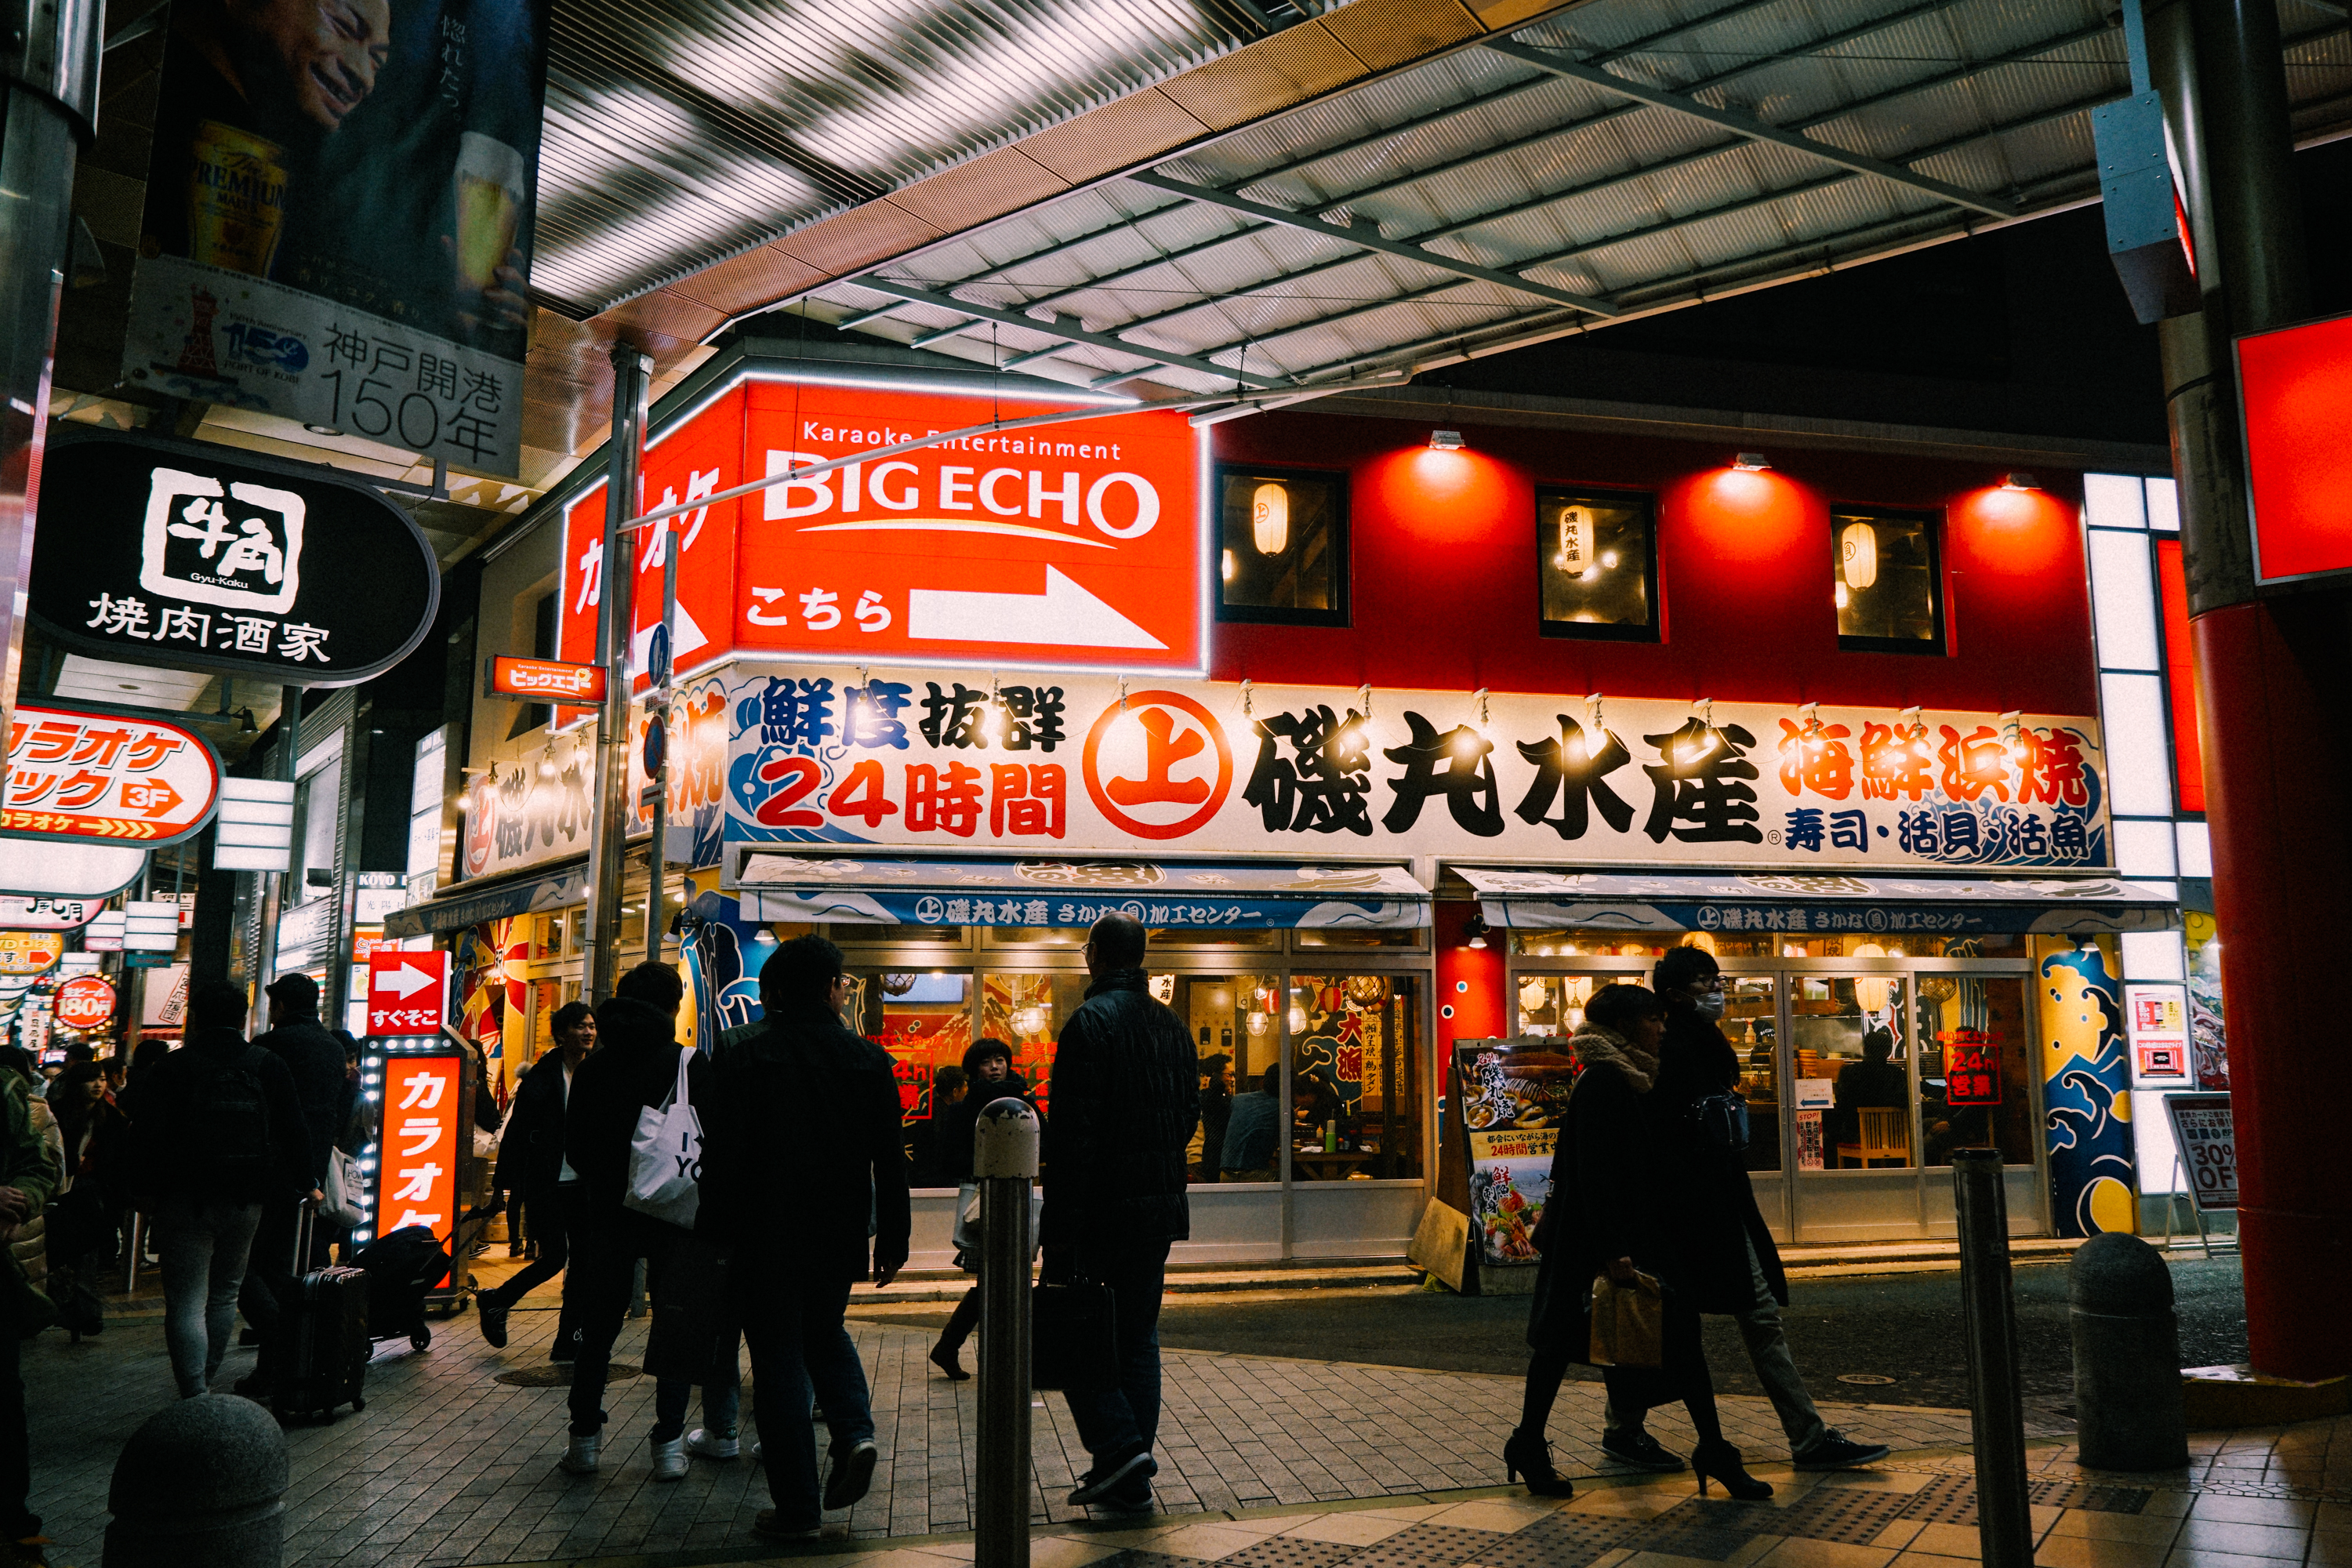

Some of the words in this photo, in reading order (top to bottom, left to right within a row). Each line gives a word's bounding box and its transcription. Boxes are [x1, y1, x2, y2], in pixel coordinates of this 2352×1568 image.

[224, 360, 254, 373] PORT
[256, 366, 271, 376] OF
[322, 322, 503, 414] 神戸開港
[321, 369, 499, 464] 150年
[803, 420, 913, 446] Karaoke
[927, 430, 1121, 460] Entertainment
[764, 449, 920, 522] BIG
[939, 465, 1160, 539] ECHO
[167, 496, 284, 585] 牛角
[575, 467, 720, 615] カオケ
[191, 572, 249, 590] Gyu-Kaku
[85, 592, 332, 663] 焼肉酒家
[746, 586, 892, 633] こちら
[510, 669, 591, 691] ビッグエコー
[760, 676, 1065, 753] 鮮度抜群
[1241, 704, 1764, 844] 磯丸水産
[1777, 717, 2090, 806] 海鮮浜焼
[6, 764, 111, 807] ック
[128, 786, 170, 808] 3F
[756, 756, 1066, 839] 24時間
[1784, 807, 2090, 859] 寿司・活貝・活魚
[359, 874, 396, 886] KOYO
[946, 899, 1049, 924] 磯丸水産
[1722, 908, 1808, 931] 磯丸水産
[56, 997, 112, 1017] 180円
[1160, 977, 1172, 1000] 水産
[372, 1008, 439, 1028] すぐそこ
[1951, 1051, 1996, 1072] 24h
[1799, 1112, 1820, 1121] STOP!
[2198, 1166, 2238, 1189] OF
